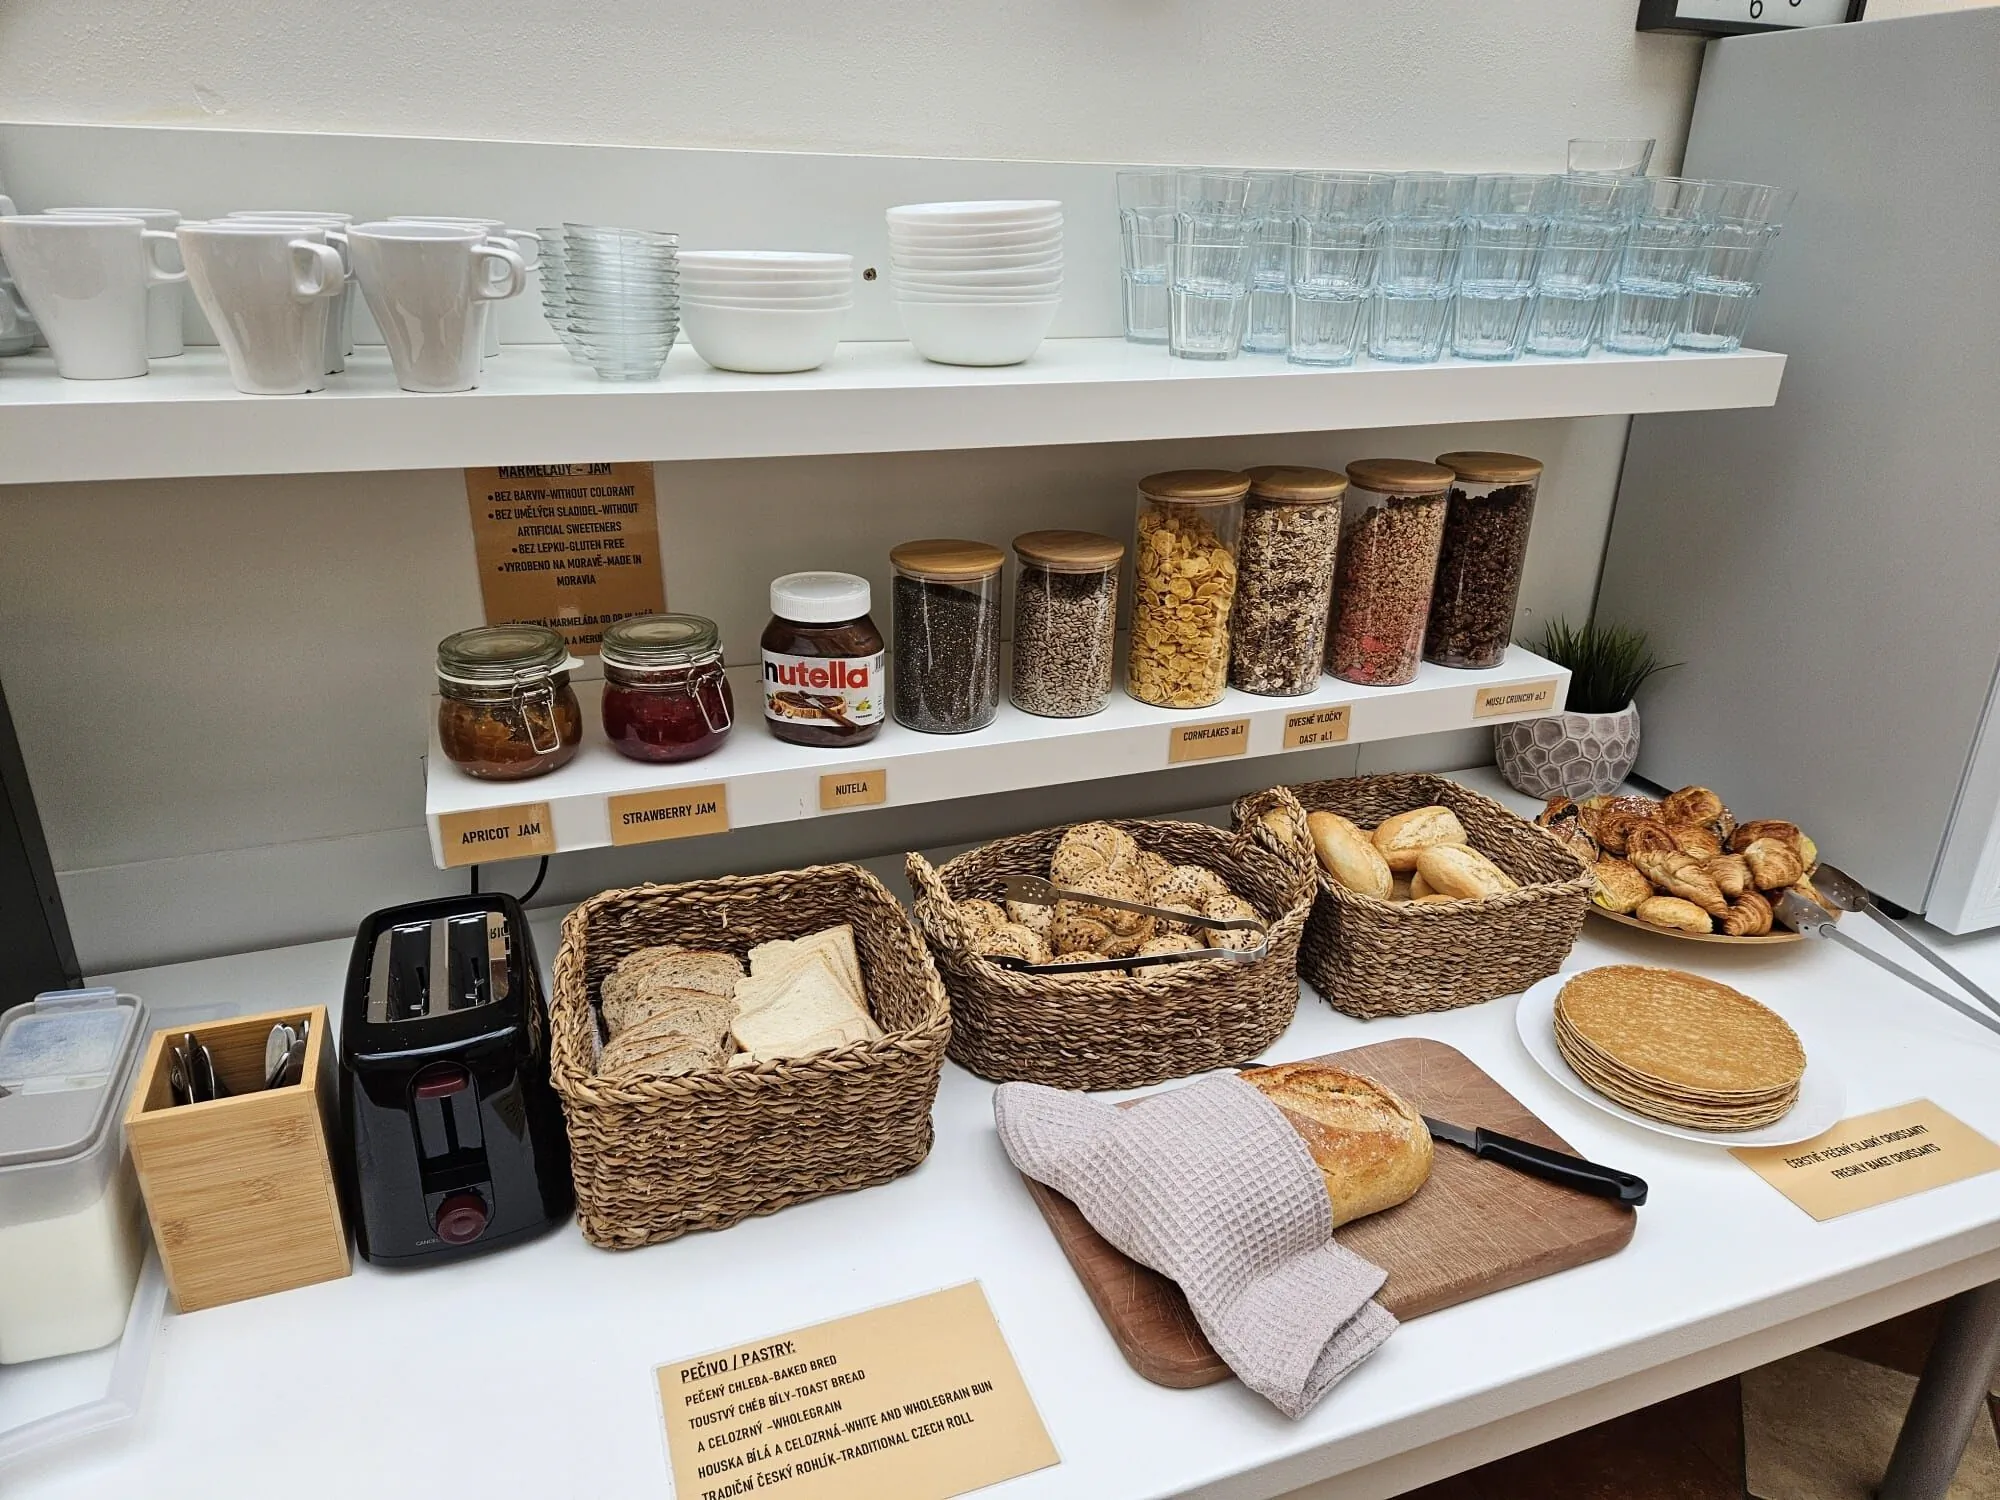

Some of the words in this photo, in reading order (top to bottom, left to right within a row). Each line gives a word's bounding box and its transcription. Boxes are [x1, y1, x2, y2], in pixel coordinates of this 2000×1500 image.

[588, 463, 611, 475] JAM
[494, 491, 512, 501] BEZ
[513, 487, 587, 501] BARVIV-WITHOUT
[590, 485, 635, 498] COLORANT
[495, 509, 512, 520] BEZ
[514, 505, 555, 519] UMĚLÝCH
[557, 503, 639, 517] SLADIDEL-WITHOUT
[518, 524, 565, 537] ARTIFICIAL
[566, 521, 622, 535] SWEETENERS
[519, 544, 536, 554] BEZ
[537, 540, 601, 553] LEPKU-GLUTEN
[604, 538, 625, 549] FREE
[504, 560, 551, 572] VYROBENO
[553, 559, 565, 570] NA
[568, 554, 631, 569] MORAVĚ-MADE
[633, 555, 642, 565] IN
[557, 575, 596, 587] MORAVIA
[550, 614, 599, 628] MARMELÁDA
[600, 614, 611, 624] OD
[765, 661, 869, 689] nutella
[1485, 696, 1506, 707] MUSLI
[1505, 692, 1534, 705] CRUNCHY
[1289, 714, 1315, 728] OVESNÉ
[1316, 711, 1343, 723] VLOČKY
[1183, 727, 1230, 742] CORNFLAKES
[1299, 733, 1317, 745] OAST
[835, 782, 868, 796] NUTELA
[623, 805, 692, 825] STRAWBERRY
[694, 801, 717, 815] JAM
[462, 827, 510, 844] APRICOT
[517, 823, 541, 837] JAM
[1880, 1124, 1929, 1143] CROISSANTY
[1831, 1164, 1871, 1180] FRESHLY
[1890, 1143, 1942, 1162] CROISSANTS
[680, 1358, 728, 1383] PEČIVO
[741, 1341, 796, 1366] PASTRY:
[685, 1384, 725, 1407] PEČENÝ
[729, 1363, 808, 1394] CHLEBA-BAKED
[811, 1355, 837, 1371] BRED
[688, 1405, 735, 1430] TOUSTVÝ
[769, 1380, 828, 1407] BÍLY-TOAST
[832, 1369, 866, 1388] BREAD
[697, 1441, 706, 1453] A
[708, 1423, 763, 1449] CELOZRNÝ
[767, 1400, 842, 1430] -WHOLEGRAIN
[697, 1456, 744, 1479] HOUSKA
[747, 1444, 771, 1464] BÍLÁ
[775, 1443, 784, 1455] A
[785, 1414, 878, 1452] CELOZRNÁ-WHITE
[880, 1407, 902, 1424] AND
[903, 1387, 971, 1415] WHOLEGRAIN
[972, 1380, 993, 1396] BUN
[701, 1475, 754, 1500] TRADIČNÍ
[757, 1464, 793, 1488] ČESKÝ
[795, 1431, 910, 1477] ROHLÍK-TRADITIONAL
[911, 1421, 945, 1440] CZECH
[947, 1411, 975, 1429] ROLL
